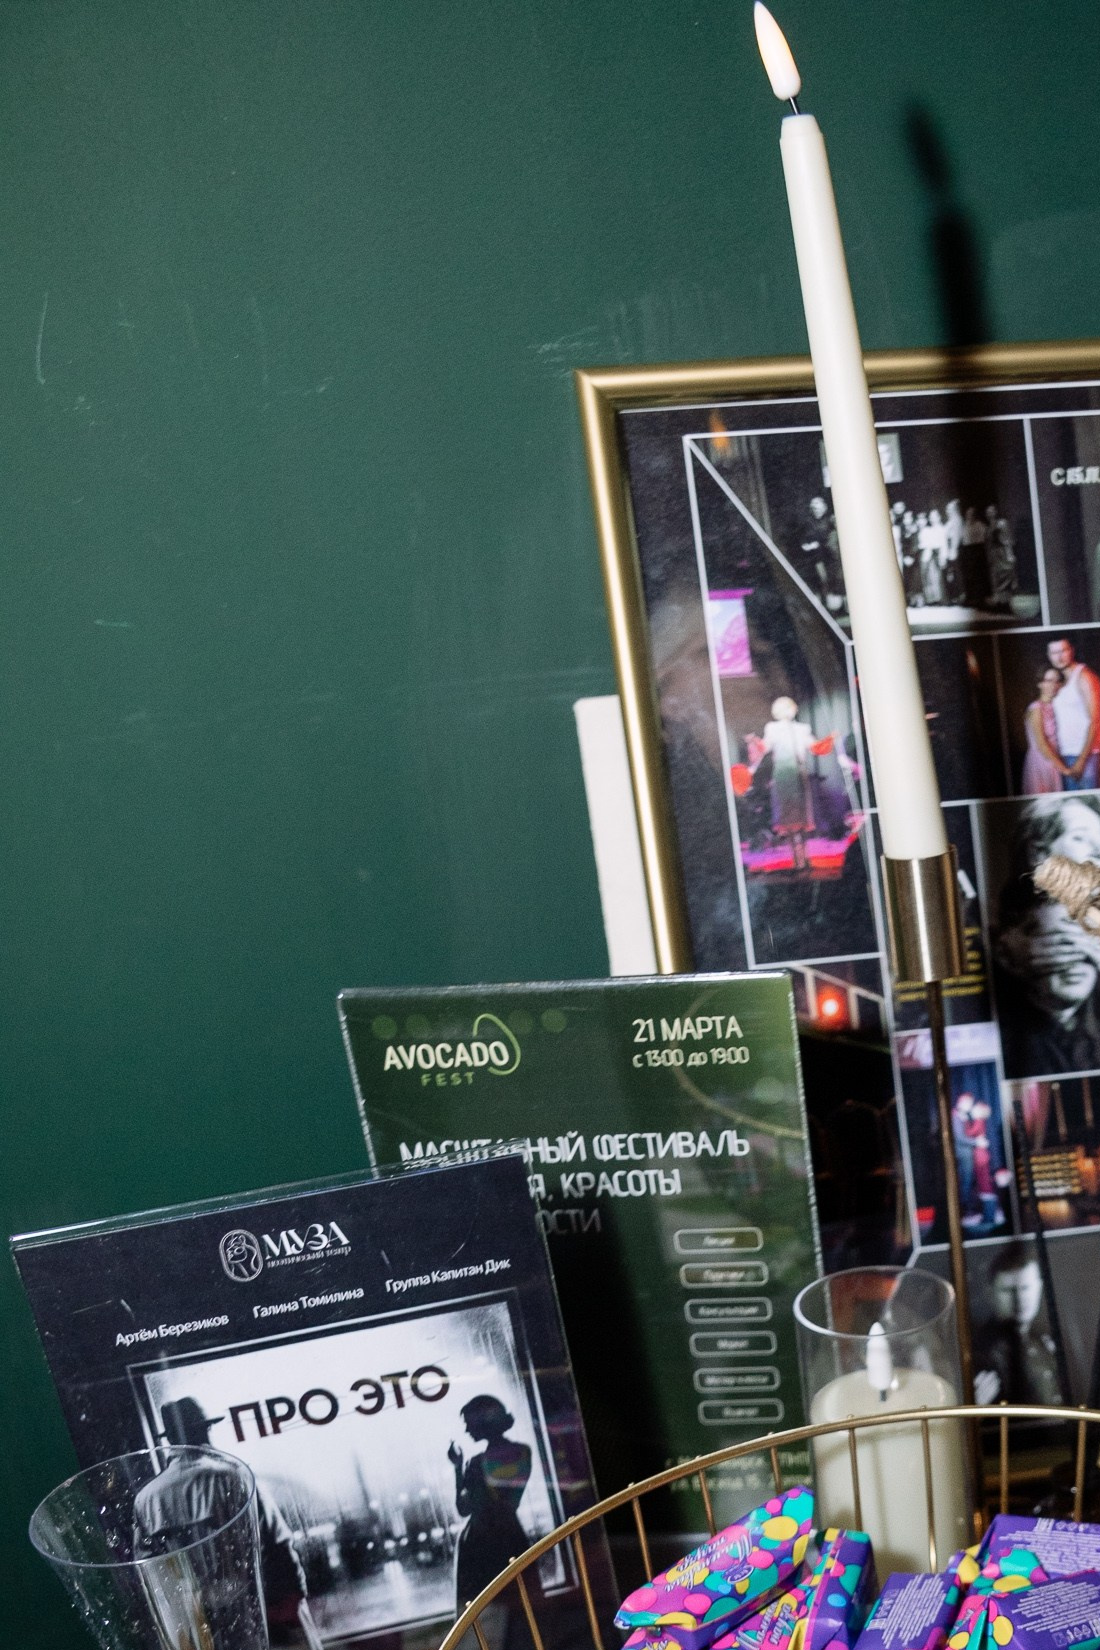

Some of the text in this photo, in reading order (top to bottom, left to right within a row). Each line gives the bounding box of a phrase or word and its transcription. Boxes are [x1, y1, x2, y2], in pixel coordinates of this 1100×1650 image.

[632, 1015, 744, 1043] 21 МАРТА
[384, 1040, 509, 1071] AVOCADO
[632, 1054, 644, 1068] с
[686, 1051, 708, 1068] до
[420, 1071, 474, 1086] FEST
[593, 1130, 751, 1163] ФЕСТИВАЛЬ
[560, 1168, 682, 1200] КРАСОТЫ
[261, 1221, 351, 1261] МУЗА
[385, 1257, 512, 1294] Группа Капитан Дик
[252, 1287, 364, 1319] Галина Томилина
[115, 1313, 230, 1346] Артём Березиков
[228, 1364, 450, 1443] ПРО ЭТО
